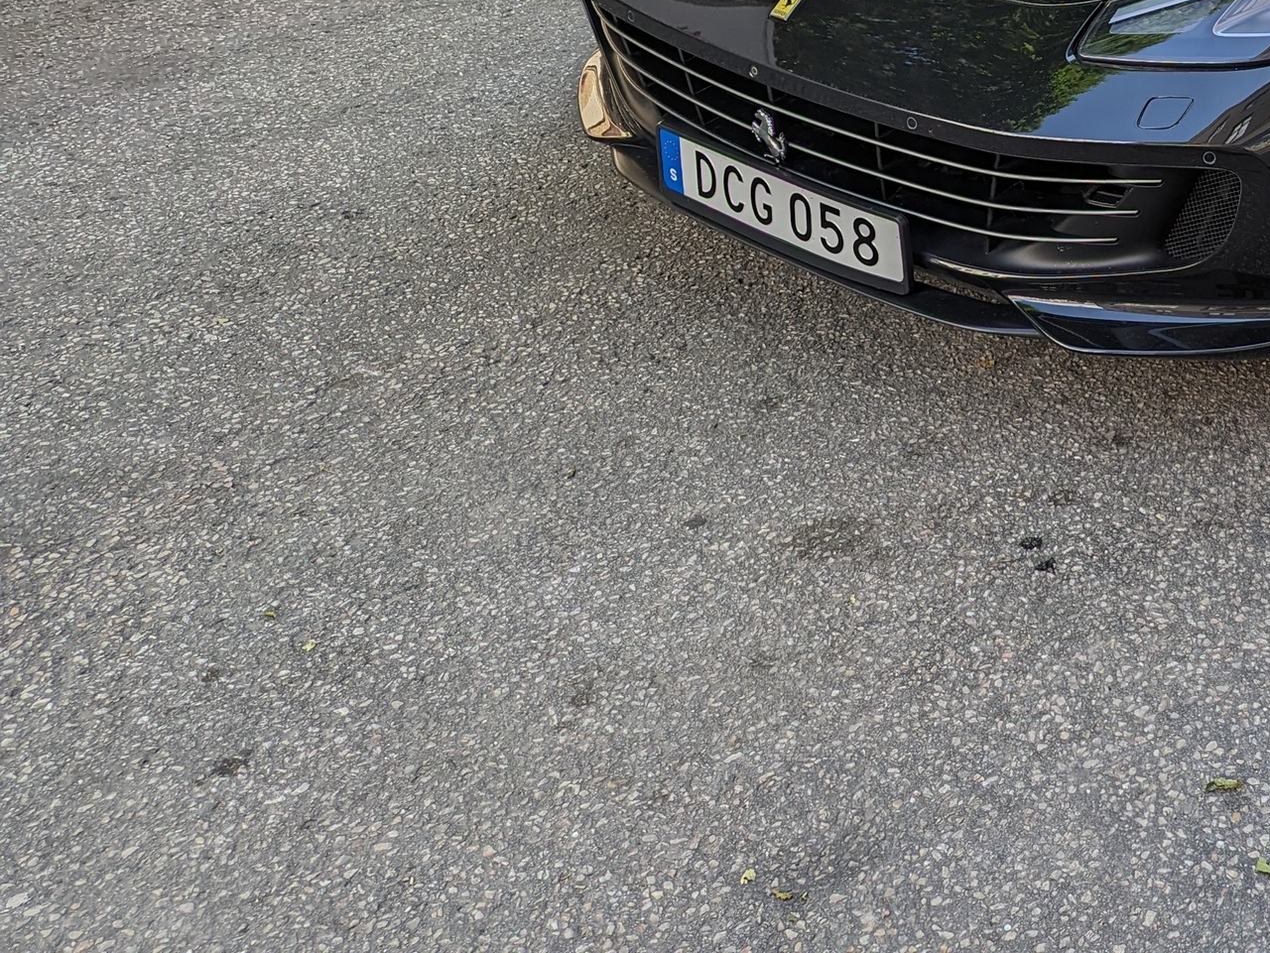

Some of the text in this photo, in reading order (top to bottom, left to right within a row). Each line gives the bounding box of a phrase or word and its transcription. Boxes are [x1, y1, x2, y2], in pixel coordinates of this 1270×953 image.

[670, 168, 678, 182] S
[694, 150, 879, 267] DCG 058
